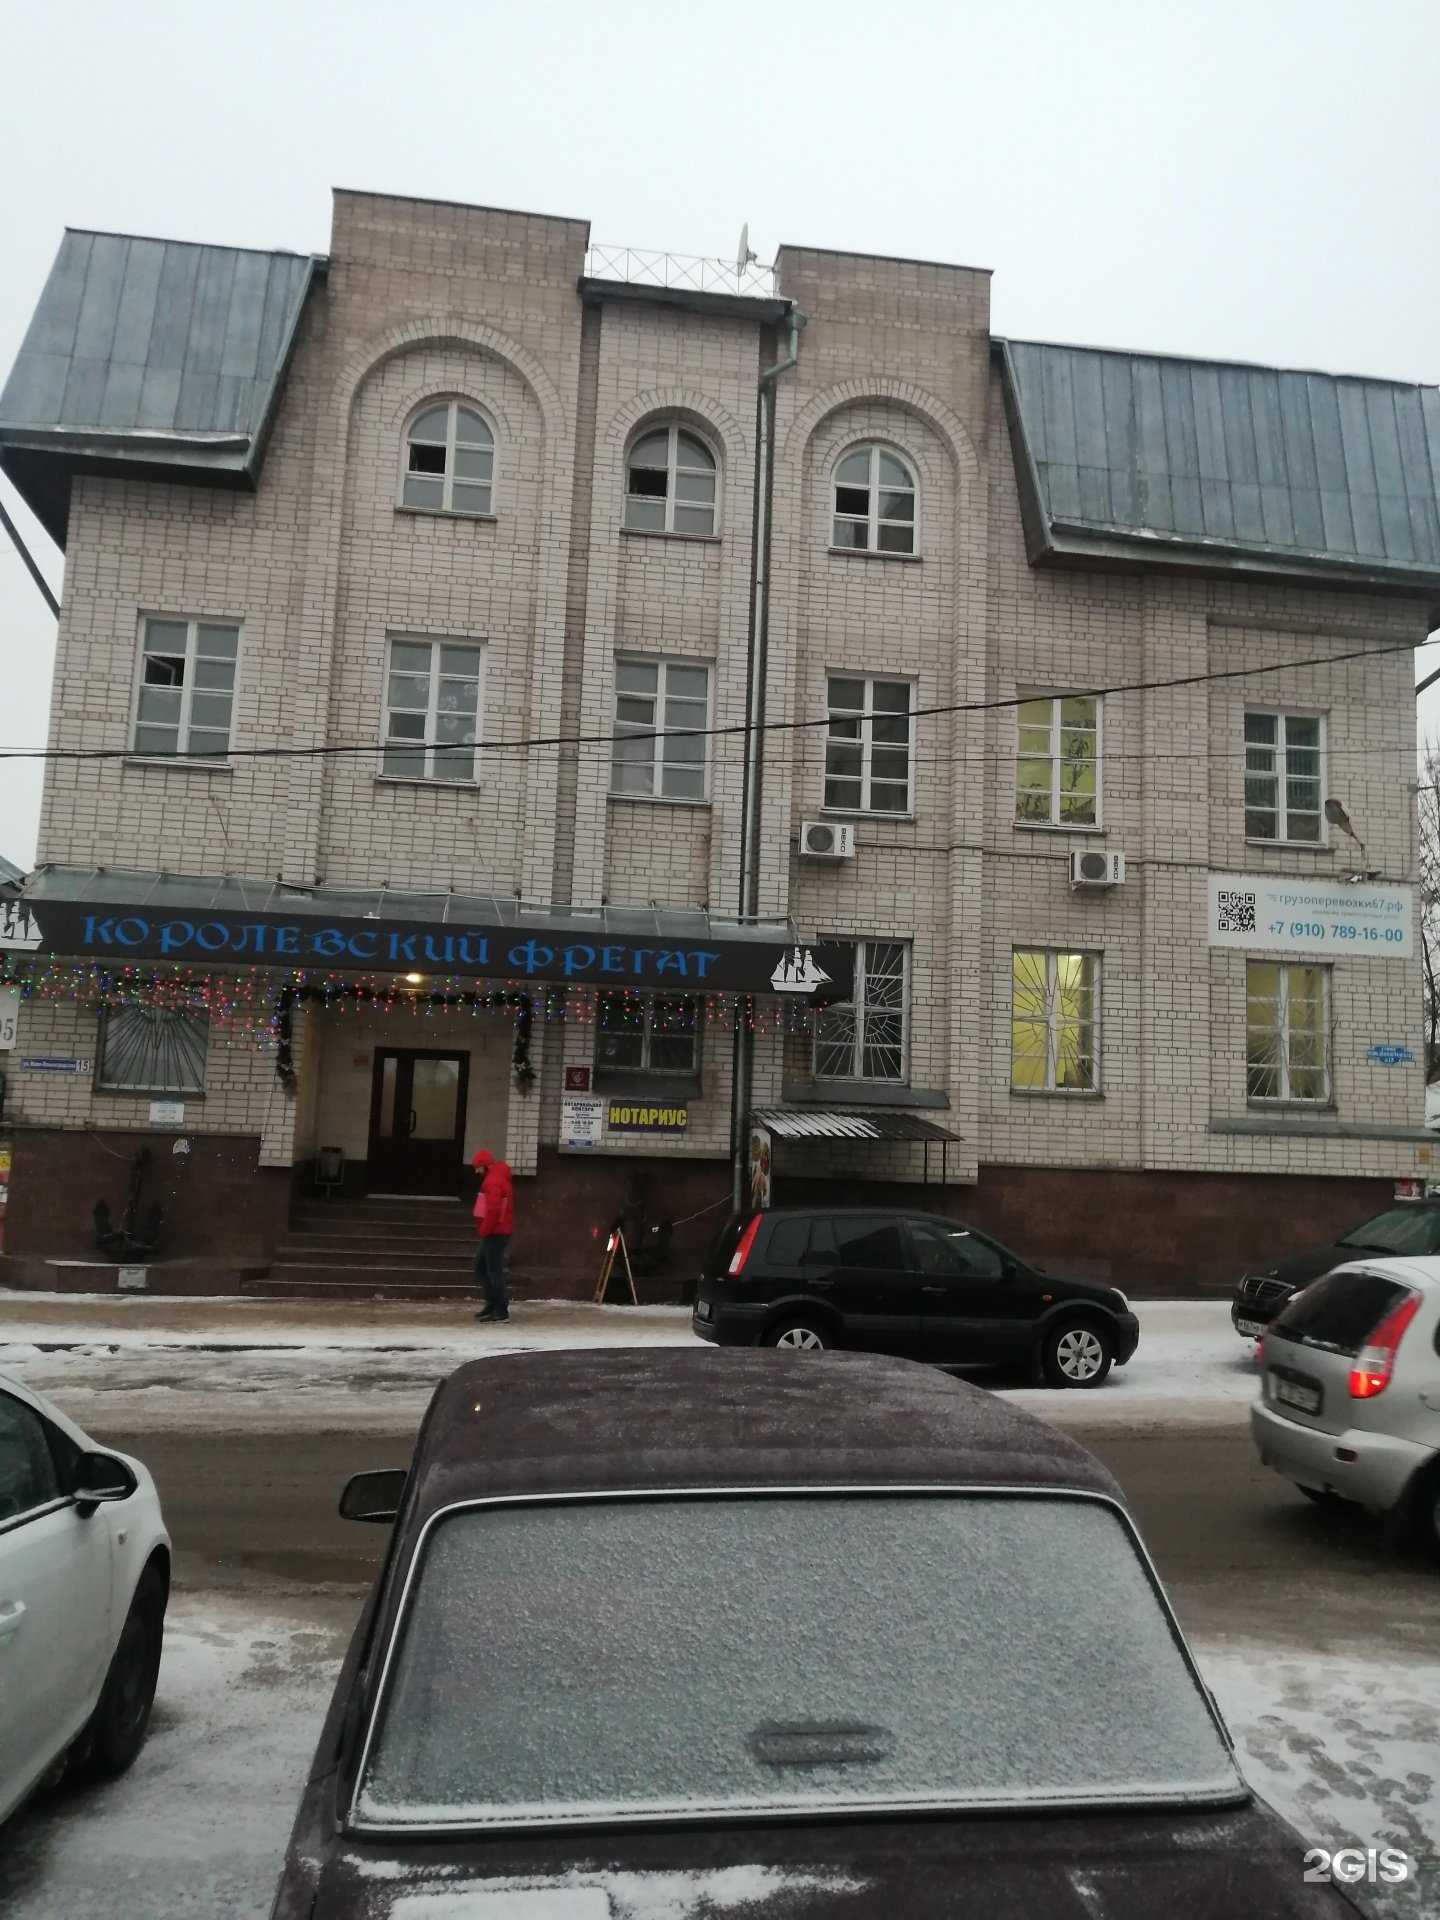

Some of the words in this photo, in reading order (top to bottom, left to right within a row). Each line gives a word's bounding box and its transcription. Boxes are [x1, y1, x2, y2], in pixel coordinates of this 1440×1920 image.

[1268, 921, 1285, 935] +7
[1290, 922, 1325, 939] (910)
[1331, 924, 1403, 942] 789-16-00
[80, 912, 489, 964] КОРОЛЕВСКИЙ
[508, 938, 721, 977] ФРЕГАТ
[609, 1107, 688, 1127] НОТАРИУС
